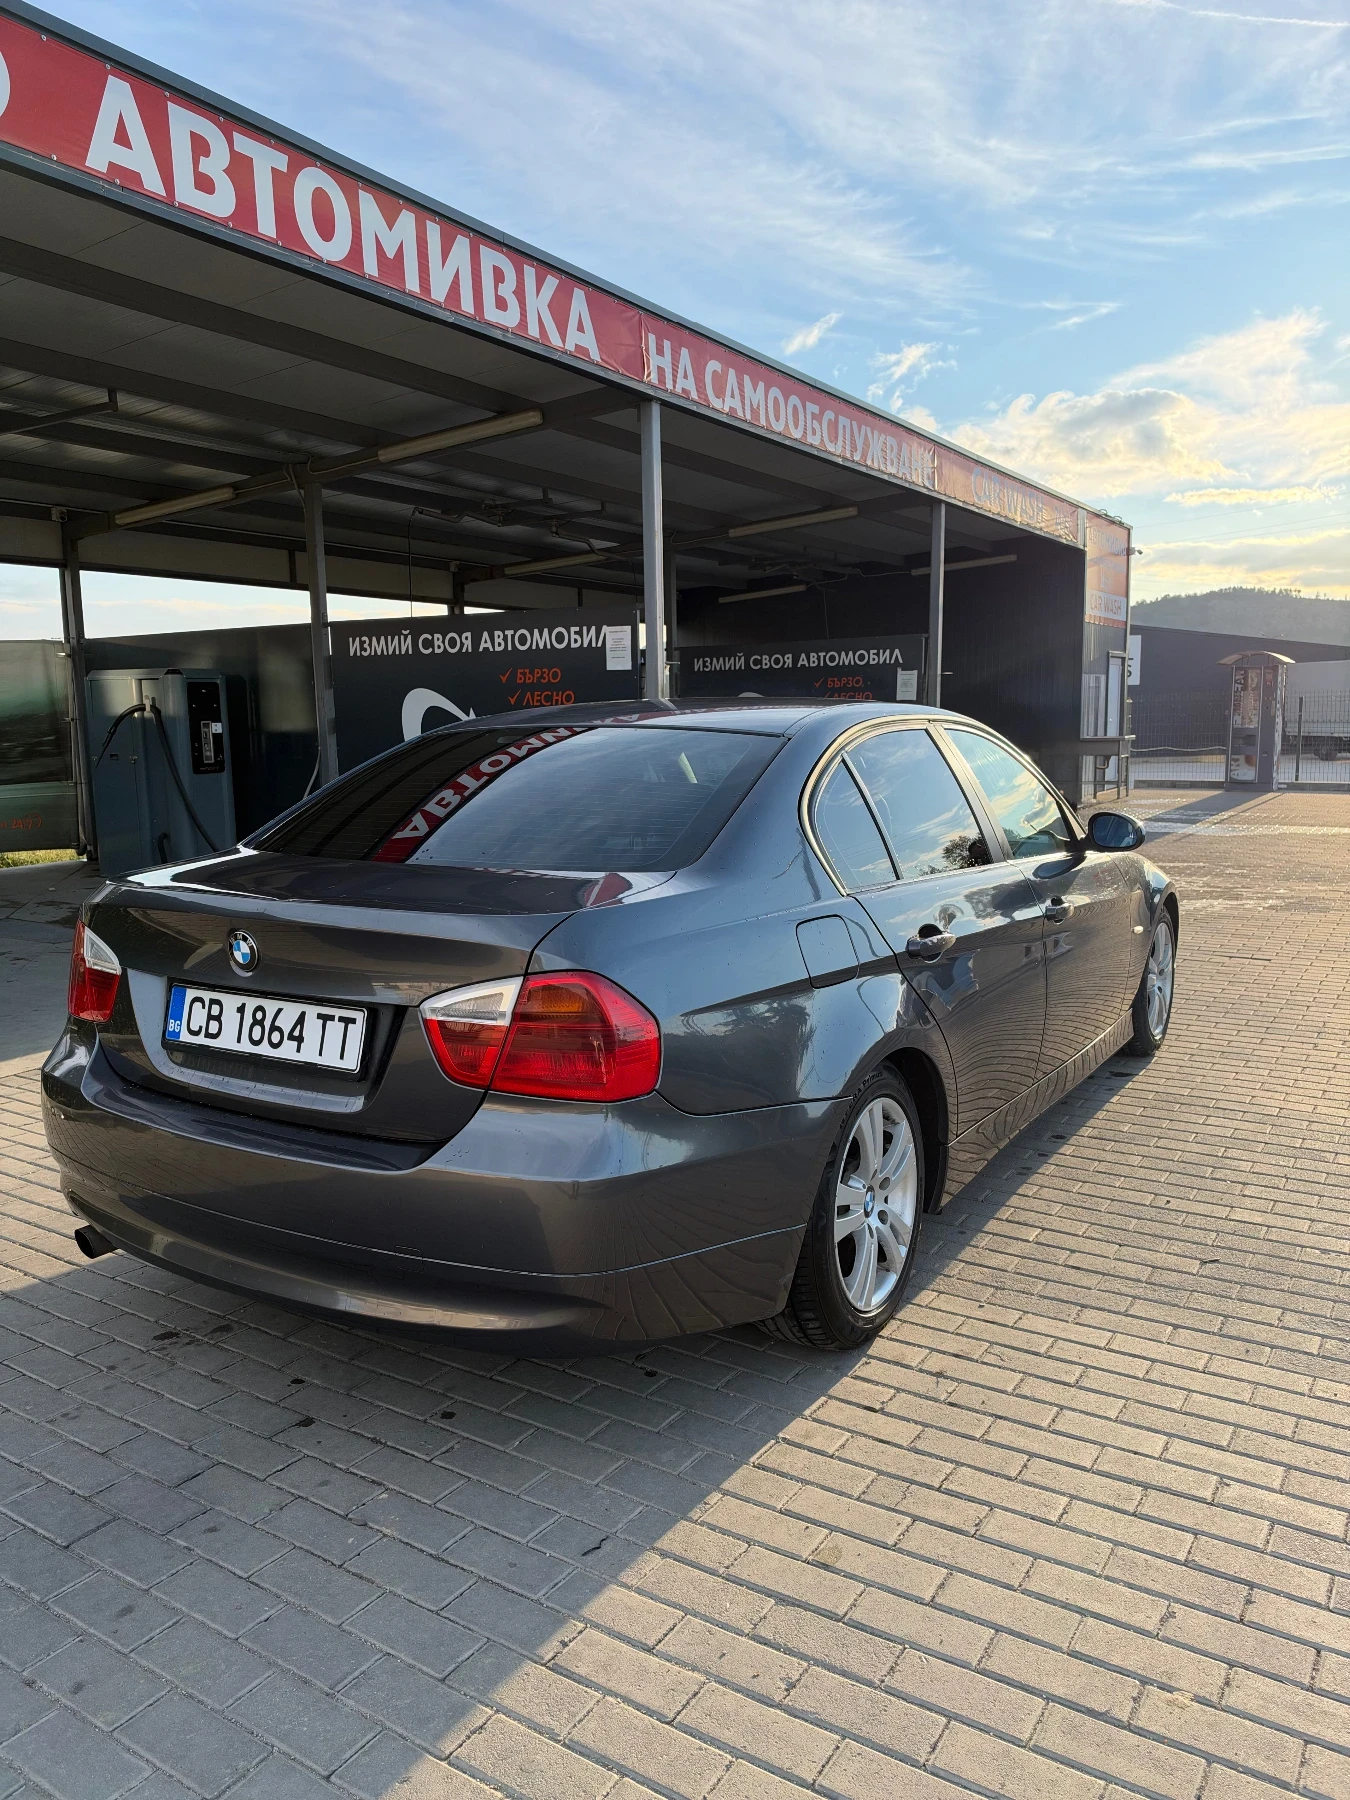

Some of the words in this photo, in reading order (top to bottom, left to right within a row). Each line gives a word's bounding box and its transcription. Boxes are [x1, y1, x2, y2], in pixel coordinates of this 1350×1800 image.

[86, 74, 600, 360] АВТОМИВКА
[648, 333, 698, 399] НА
[972, 468, 1002, 512] CAR
[1003, 484, 1044, 524] WASH
[1090, 593, 1103, 613] CAR
[1104, 596, 1122, 617] WASH
[349, 629, 412, 657] ИЗМИЙ
[418, 632, 472, 654] СВОЯ
[694, 652, 745, 672] ИЗМИЙ
[750, 653, 793, 670] СВОЯ
[797, 649, 903, 668] АВТОМОБИЛ
[516, 668, 561, 684] БЪРЗО
[827, 676, 863, 688] БЪРЗО
[523, 690, 575, 707] ЛЕСНО
[168, 1019, 181, 1033] BG
[186, 996, 224, 1040] CB
[236, 1002, 307, 1054] 1864
[316, 1012, 357, 1061] TT
